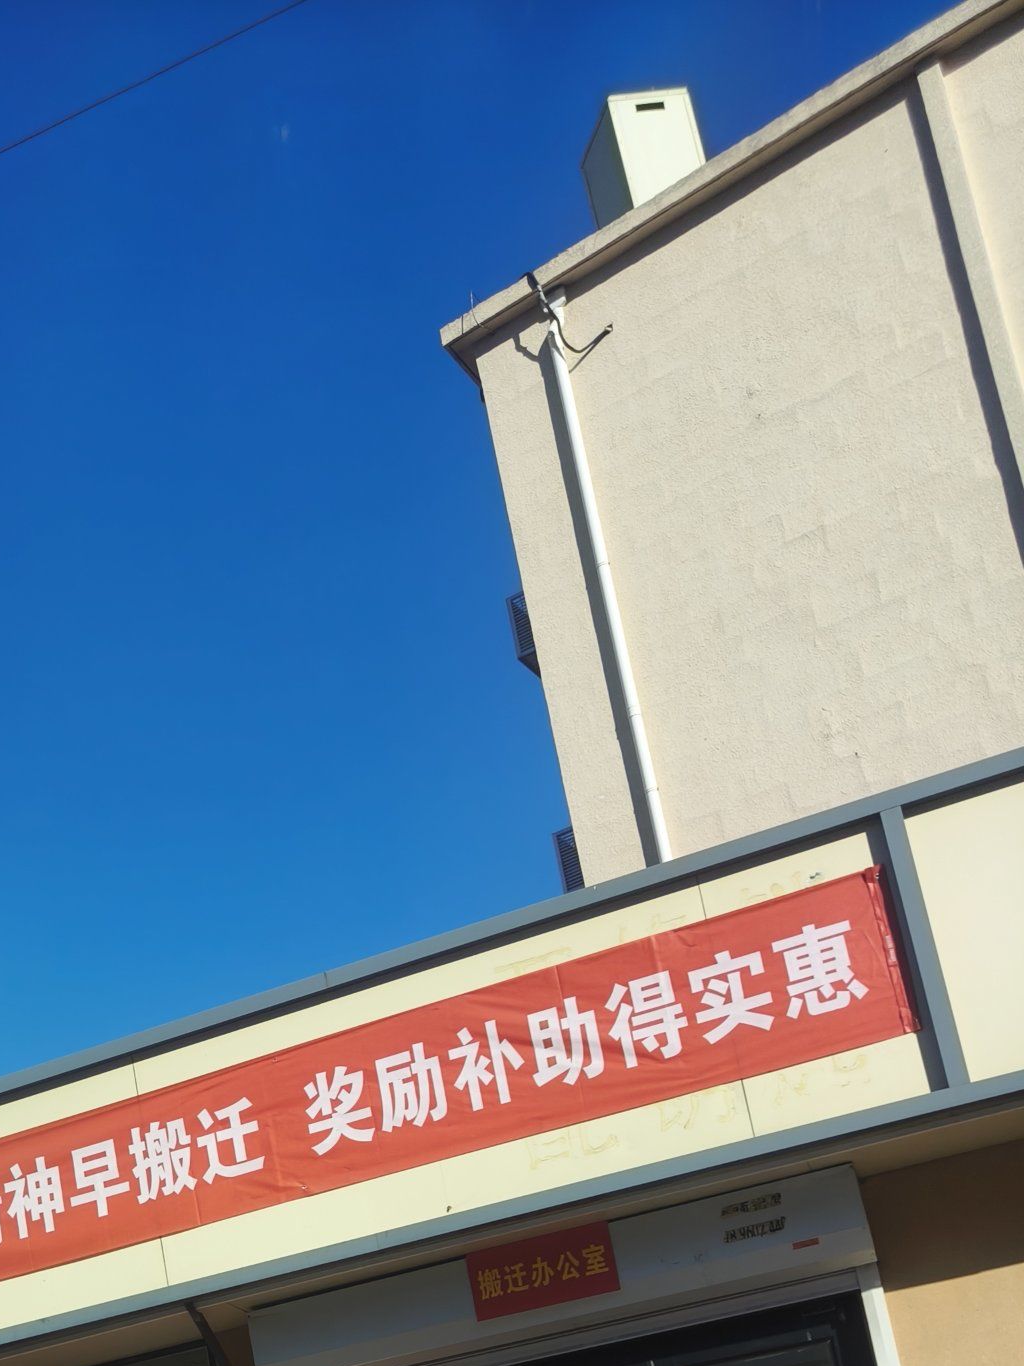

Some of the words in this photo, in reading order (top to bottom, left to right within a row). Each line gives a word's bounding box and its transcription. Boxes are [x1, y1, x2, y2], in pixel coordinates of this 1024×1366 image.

[305, 920, 869, 1155] 奖励补助得实惠
[478, 1244, 611, 1300] 搬迁办公室
